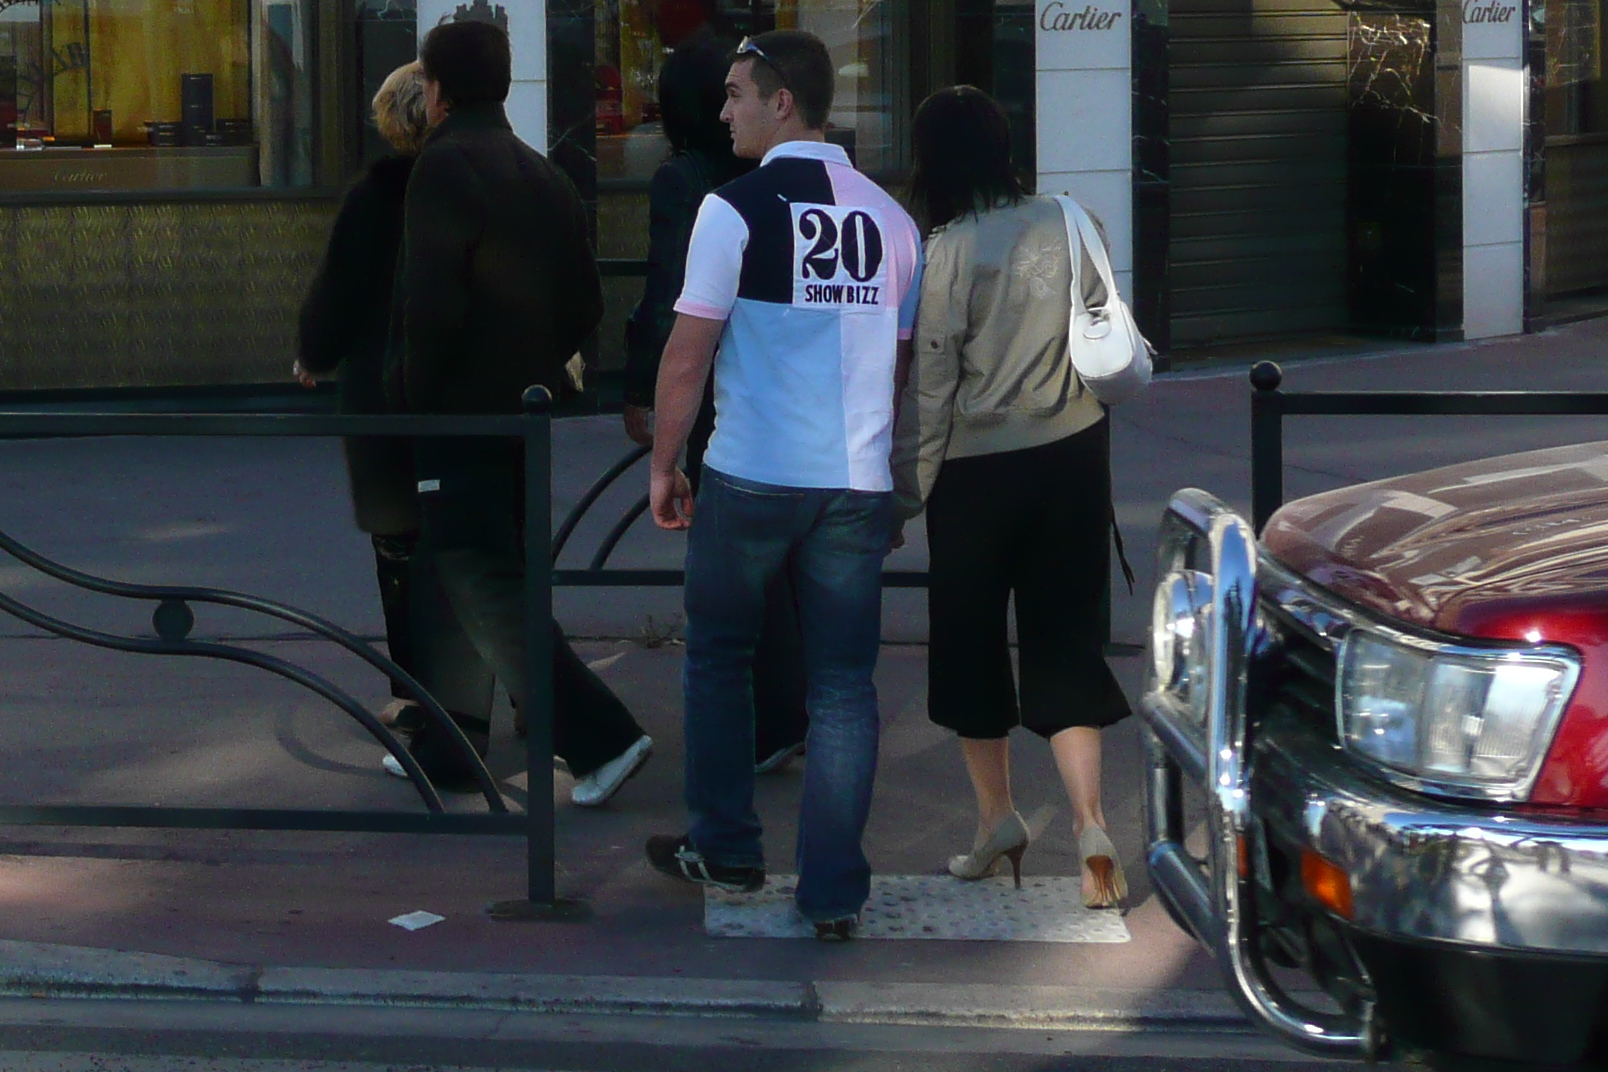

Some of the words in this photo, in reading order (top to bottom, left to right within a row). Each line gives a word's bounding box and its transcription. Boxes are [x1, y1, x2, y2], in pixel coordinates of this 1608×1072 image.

[1038, 1, 1123, 33] Cartier
[798, 208, 884, 283] 20
[804, 284, 843, 304] SHOW
[846, 285, 880, 305] BIZZ
